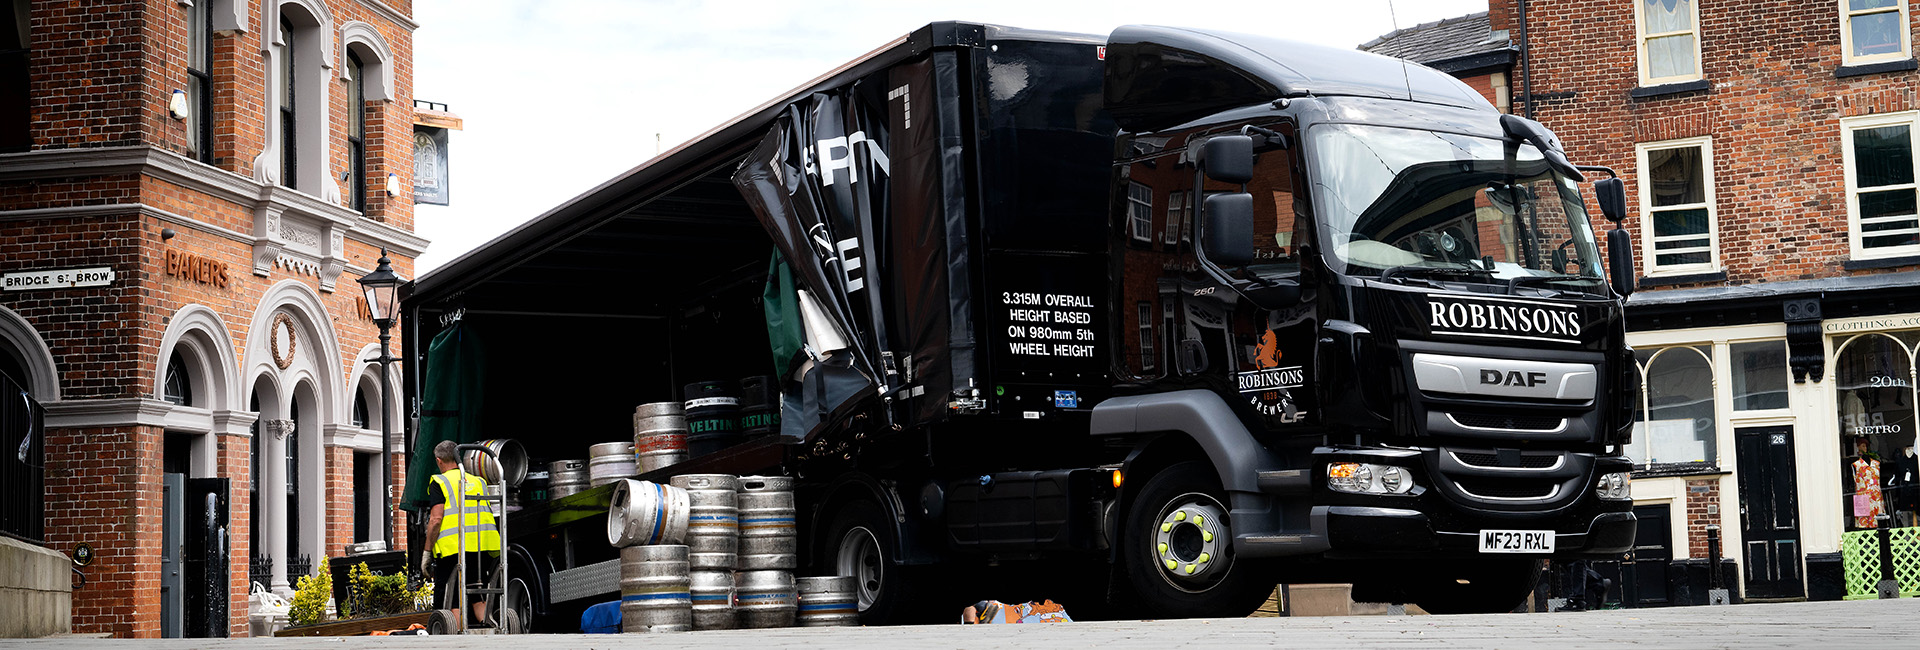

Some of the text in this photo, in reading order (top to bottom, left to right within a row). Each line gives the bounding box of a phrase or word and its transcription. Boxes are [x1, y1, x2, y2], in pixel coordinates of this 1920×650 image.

[166, 249, 229, 289] BAKERS
[6, 275, 50, 287] BRIDGE
[76, 272, 109, 283] BROW
[1002, 291, 1095, 308] 3.315M OVERALL
[1009, 308, 1091, 324] HEIGHT BASED
[1429, 301, 1581, 336] ROBINSONS
[1008, 325, 1095, 341] ON 980mm 5th
[1009, 342, 1095, 357] WHEEL HEIGHT
[1238, 369, 1304, 390] ROBINSONS
[1479, 368, 1547, 387] DAF
[1870, 375, 1907, 388] 20th
[1250, 391, 1293, 416] BREWERY
[1280, 411, 1307, 424] LF
[1855, 424, 1901, 435] RETRO
[1772, 434, 1785, 444] 26
[1485, 532, 1550, 550] MF23 RXL
